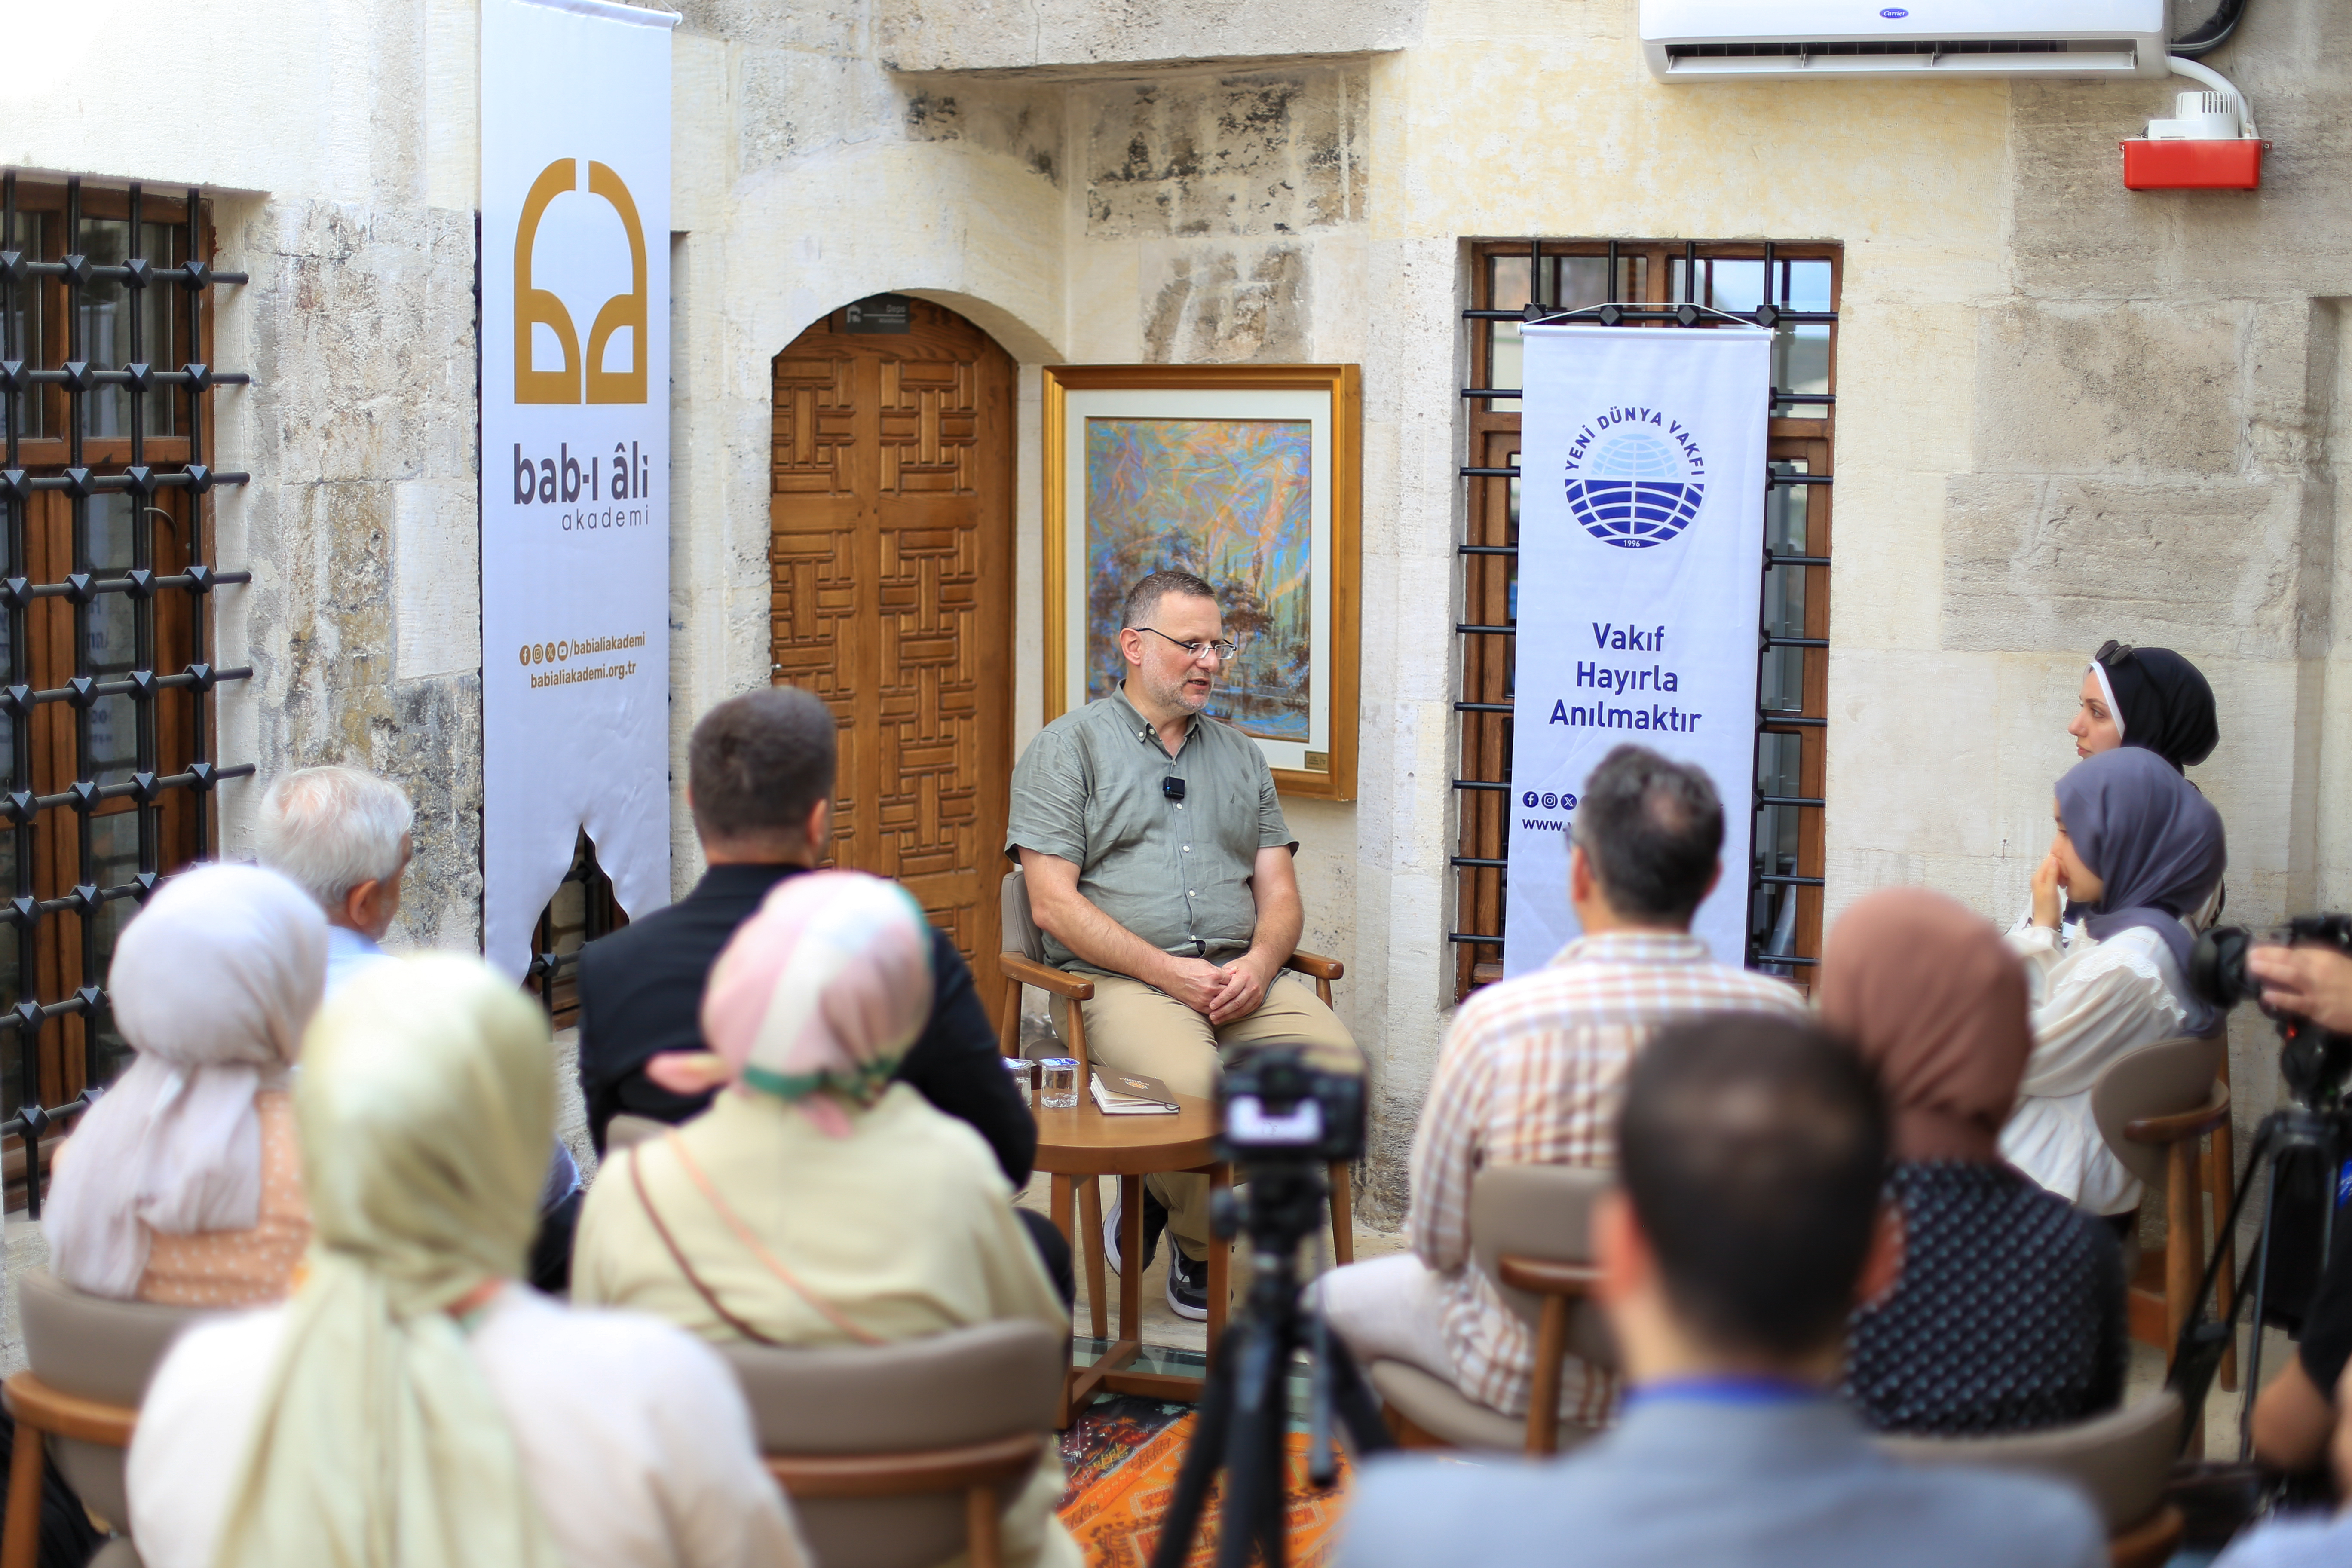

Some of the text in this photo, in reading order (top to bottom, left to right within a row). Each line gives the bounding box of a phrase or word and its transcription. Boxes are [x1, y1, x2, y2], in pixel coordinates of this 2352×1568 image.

[1565, 405, 1705, 475] YENİ DÜNYA VAKFI
[611, 440, 648, 500] âli
[561, 505, 649, 531] akademi
[1592, 622, 1665, 652] Vakıf
[530, 660, 636, 689] babialiakademi.org.tr
[1576, 661, 1678, 695] Hayırla
[1549, 699, 1703, 733] Anılmaktır
